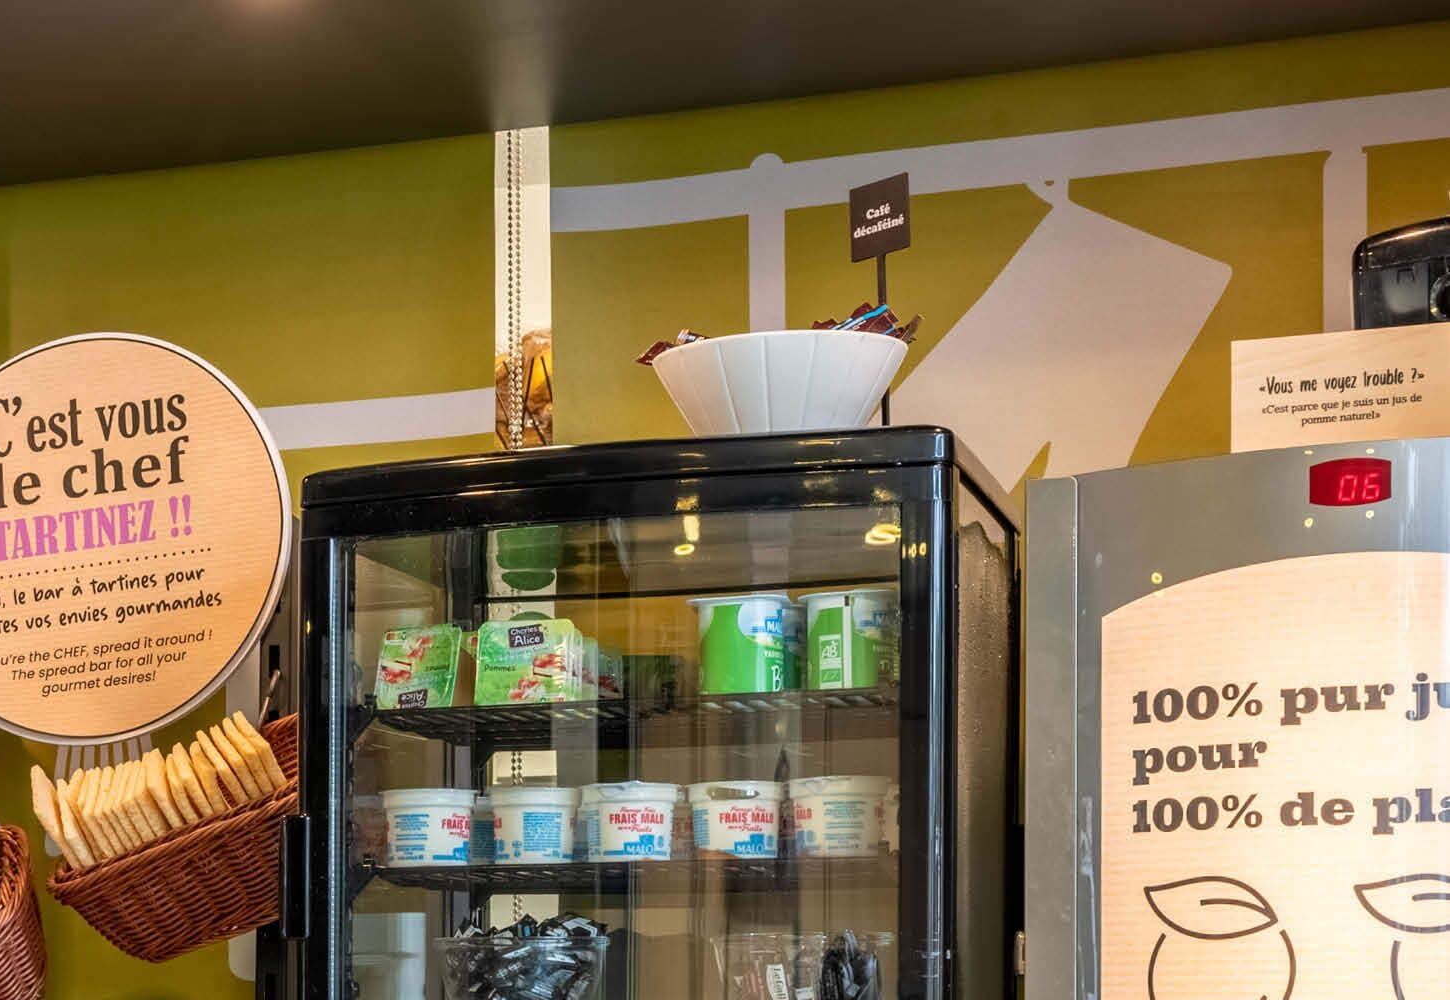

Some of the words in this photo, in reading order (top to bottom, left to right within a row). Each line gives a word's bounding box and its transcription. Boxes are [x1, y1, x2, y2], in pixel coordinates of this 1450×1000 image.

[854, 213, 904, 239] décaféiné
[866, 202, 890, 220] Café
[1300, 379, 1318, 392] me
[1324, 375, 1357, 394] voyez
[1363, 368, 1404, 388] trouble
[94, 393, 187, 443] vous
[1291, 402, 1319, 415] parce
[1321, 401, 1339, 412] que
[1341, 399, 1351, 409] je
[1353, 397, 1374, 407] suis
[1376, 395, 1390, 405] un
[1392, 394, 1407, 404] jus
[1410, 393, 1423, 403] de
[1301, 416, 1338, 427] pomme
[62, 435, 190, 499] chef
[1338, 473, 1381, 502] 06
[169, 494, 193, 539] !!
[13, 588, 26, 606] le
[33, 586, 64, 603] bar
[71, 578, 84, 598] à
[88, 574, 157, 596] tartines
[165, 568, 206, 592] pour
[25, 616, 52, 630] vos
[59, 607, 109, 627] envies
[115, 591, 222, 625] gourmandes
[28, 648, 51, 664] the
[53, 645, 90, 661] CHEF,
[92, 638, 141, 659] spread
[143, 635, 154, 650] it
[155, 630, 205, 648] around
[208, 629, 213, 641] !
[515, 635, 540, 646] Alice
[11, 667, 35, 681] The
[37, 661, 87, 682] spread
[89, 659, 113, 673] bar
[115, 656, 134, 670] for
[136, 653, 153, 668] all
[156, 650, 187, 668] your
[41, 678, 101, 697] gourmet
[103, 670, 157, 689] desires!
[1132, 682, 1264, 724] 100%
[1279, 682, 1395, 726] pur
[1132, 740, 1268, 786] pour
[609, 813, 637, 824] FRAIS
[641, 813, 664, 824] MALO
[719, 813, 747, 824] FRAIS
[752, 812, 774, 824] MALO
[1132, 793, 1264, 833] 100%
[1279, 791, 1355, 827] de
